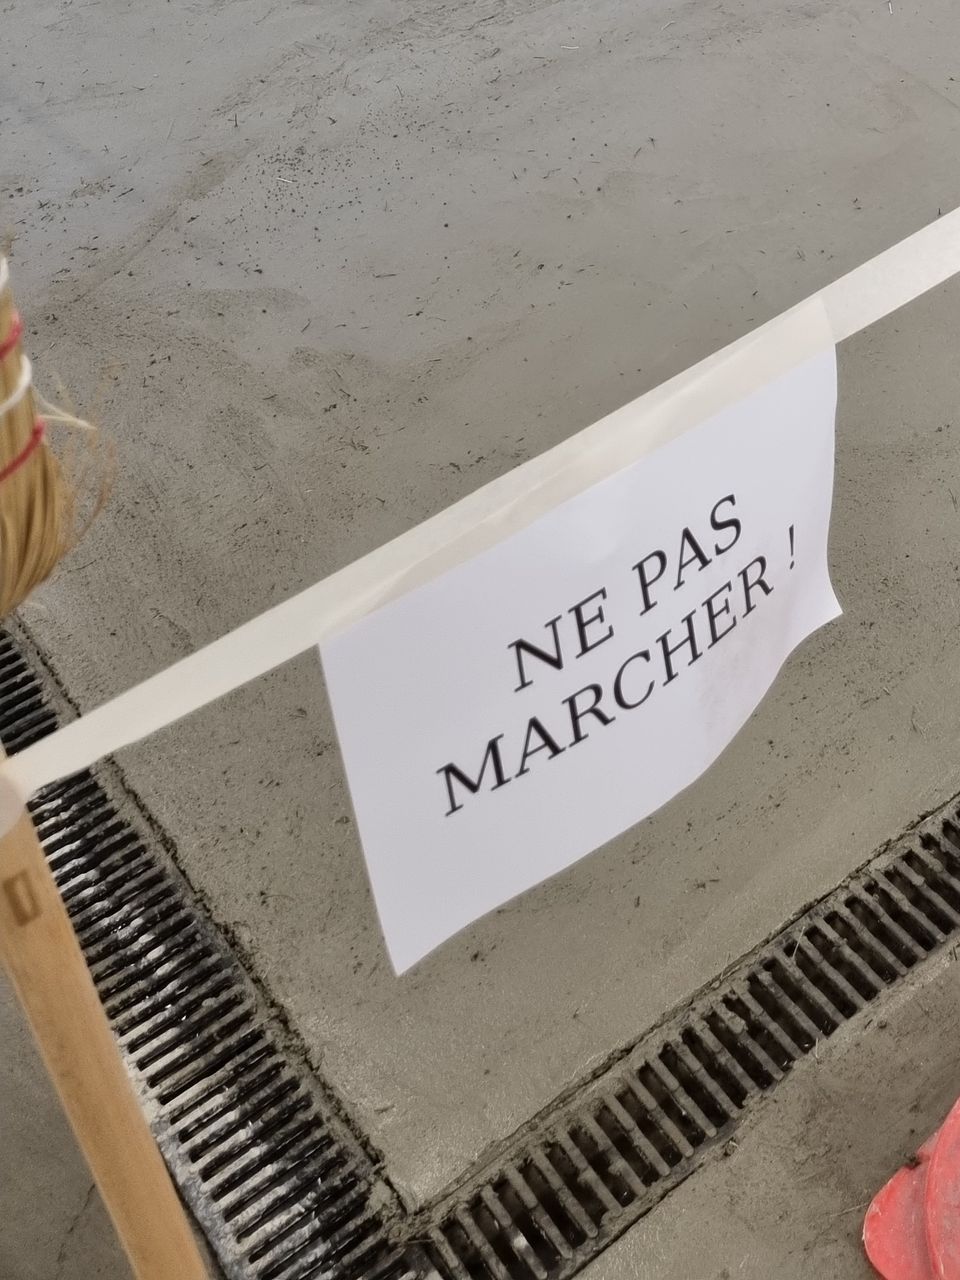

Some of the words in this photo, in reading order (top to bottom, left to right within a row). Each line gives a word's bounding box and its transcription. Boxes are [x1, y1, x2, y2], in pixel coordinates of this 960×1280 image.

[435, 554, 775, 818] MARCHER
[506, 586, 615, 693] NE
[631, 493, 742, 616] PAS
